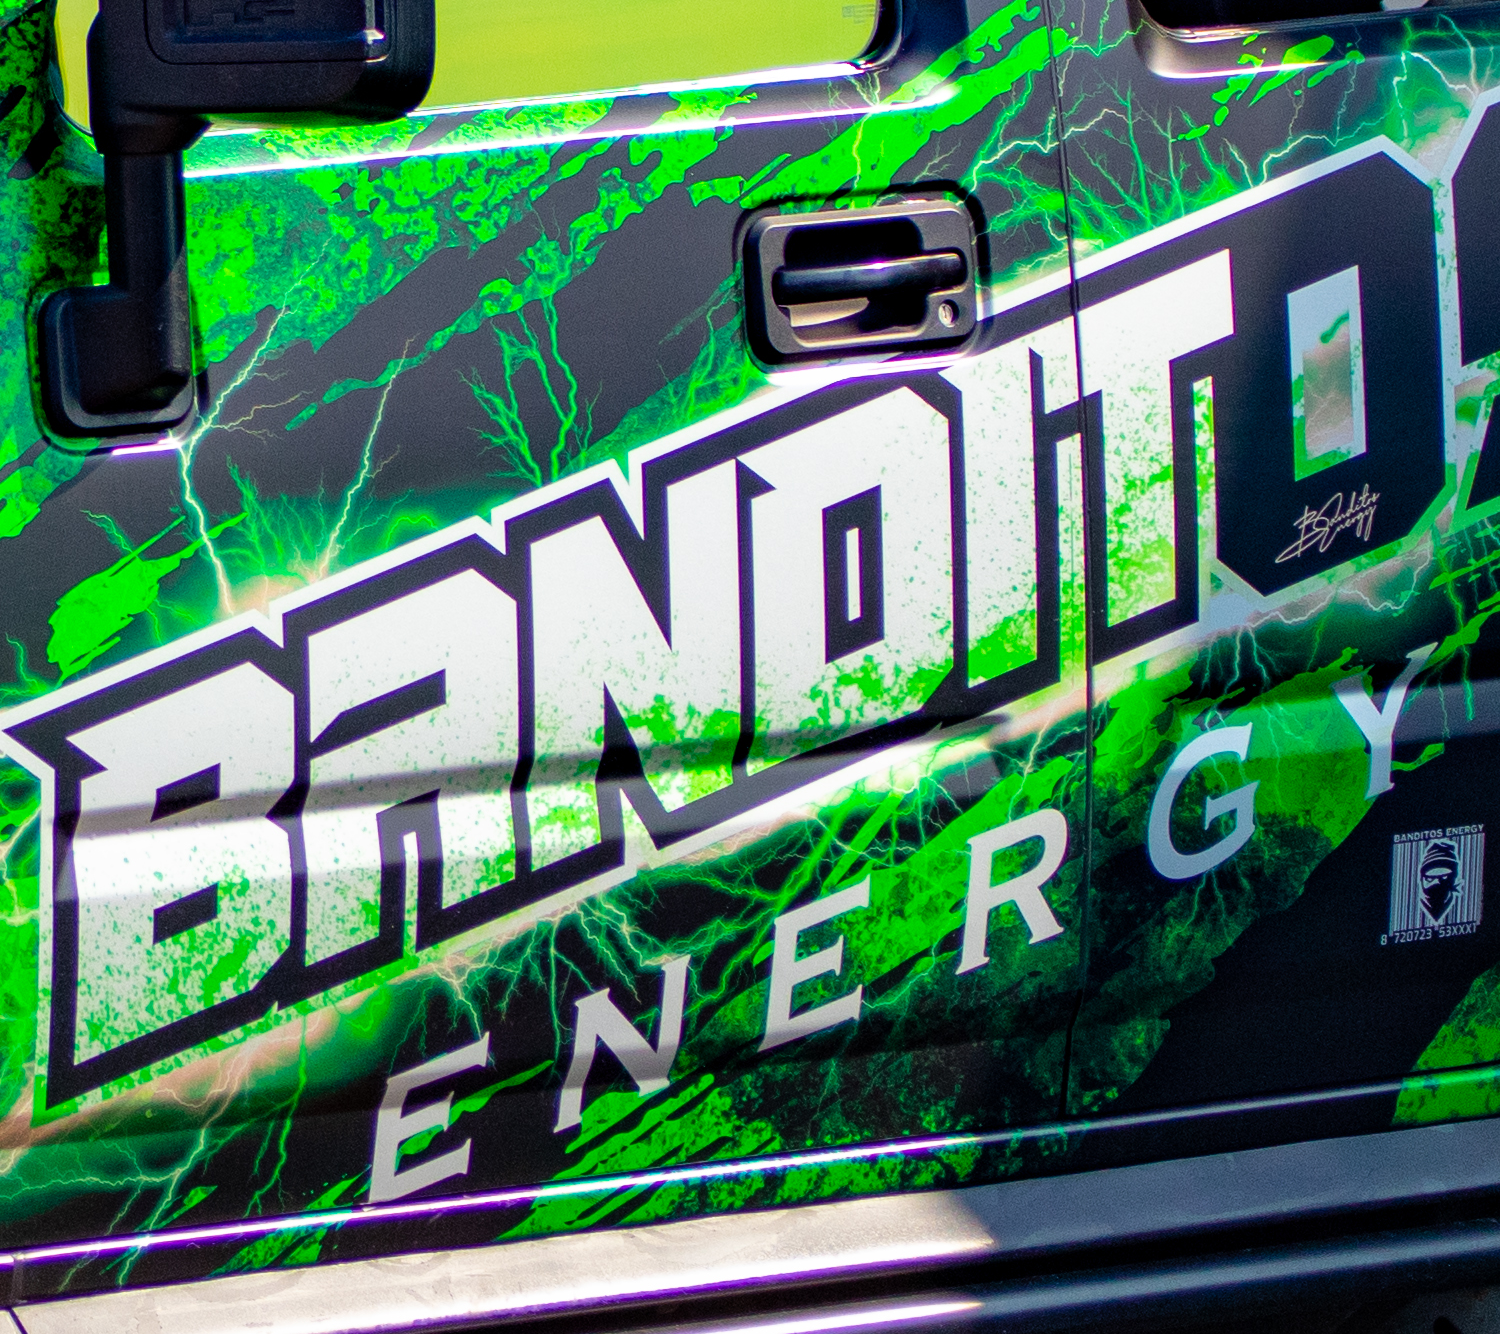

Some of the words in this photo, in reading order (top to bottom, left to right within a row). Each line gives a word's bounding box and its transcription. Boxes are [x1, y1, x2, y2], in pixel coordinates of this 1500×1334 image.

[1393, 828, 1444, 843] BANDITOS
[1445, 824, 1485, 838] ENERGY
[367, 642, 1439, 1207] ENERGY
[1380, 933, 1388, 946] 8
[1394, 928, 1432, 944] 720723
